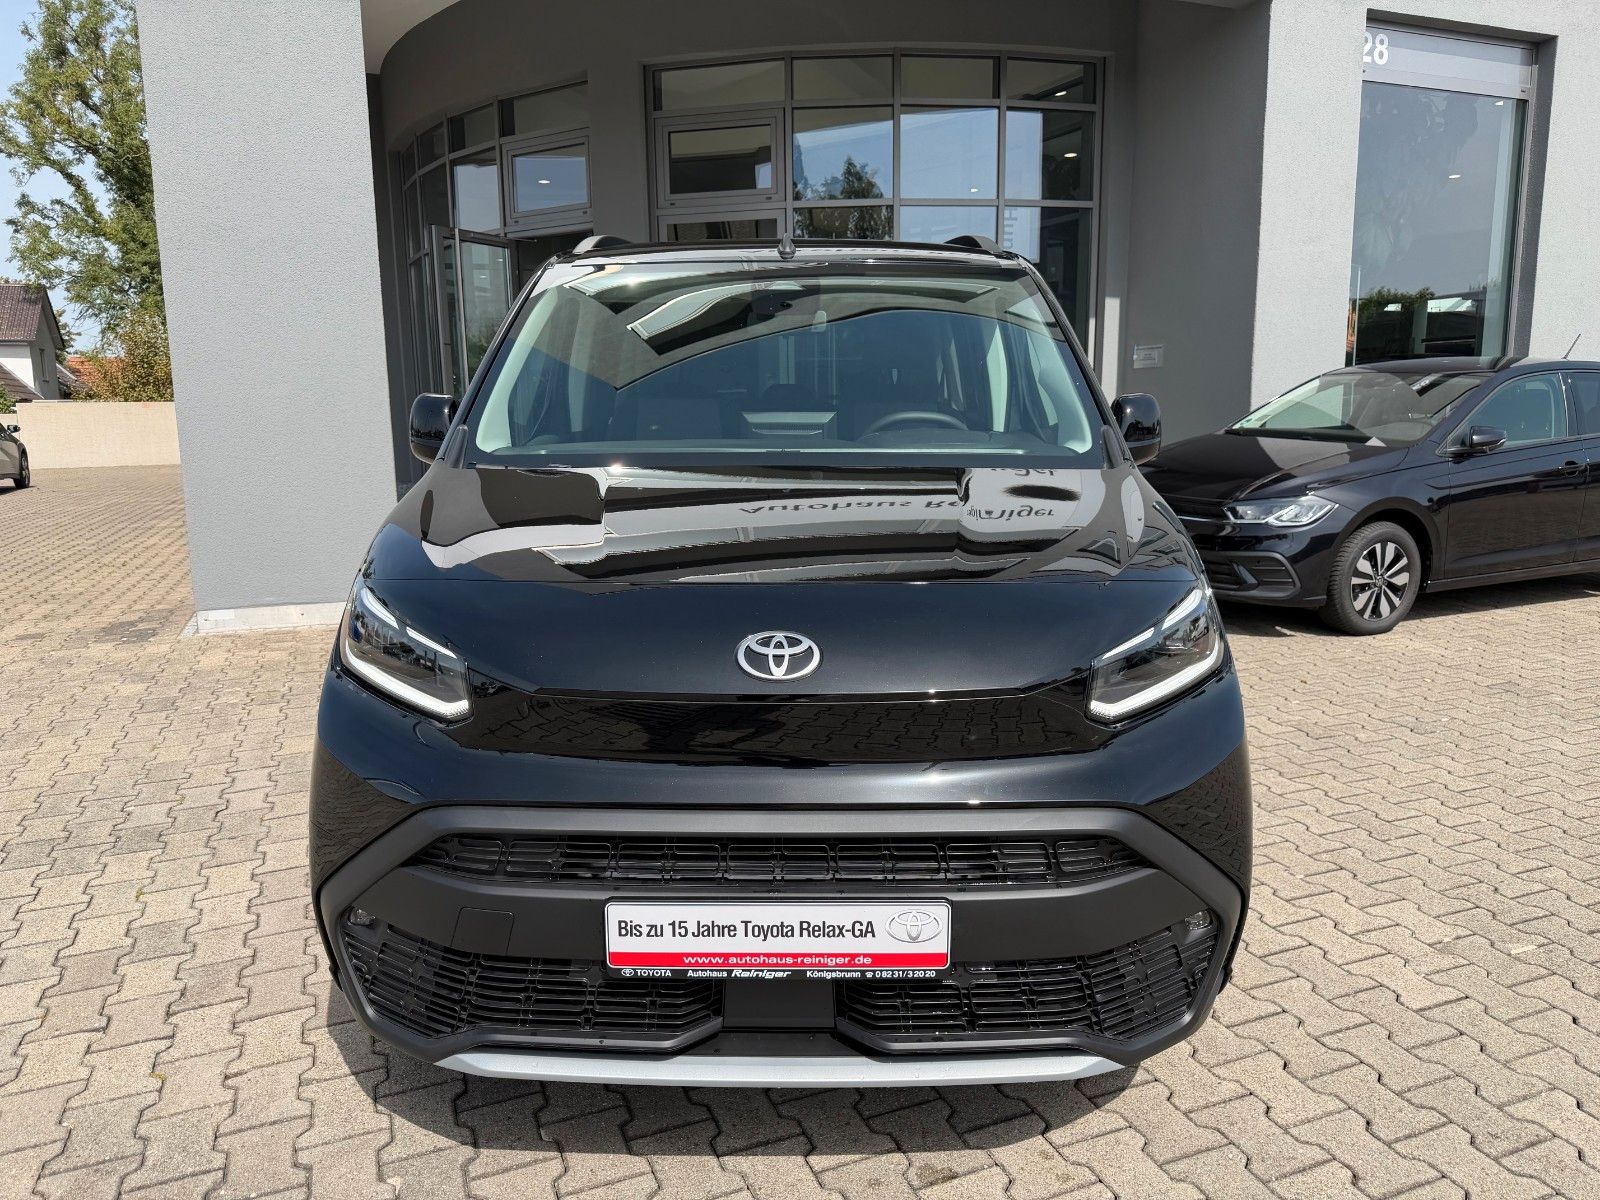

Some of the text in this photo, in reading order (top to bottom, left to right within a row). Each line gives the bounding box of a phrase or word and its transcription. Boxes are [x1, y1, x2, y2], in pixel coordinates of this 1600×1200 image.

[617, 920, 876, 941] Bis zu 15 Jahre Toyota Relax-GA
[683, 955, 872, 965] www.autohaus-reiniger.de
[636, 969, 672, 977] TOYOTA
[687, 969, 728, 977] Autohaus
[731, 969, 791, 979] Reiniger
[806, 970, 861, 979] Königsbrunn
